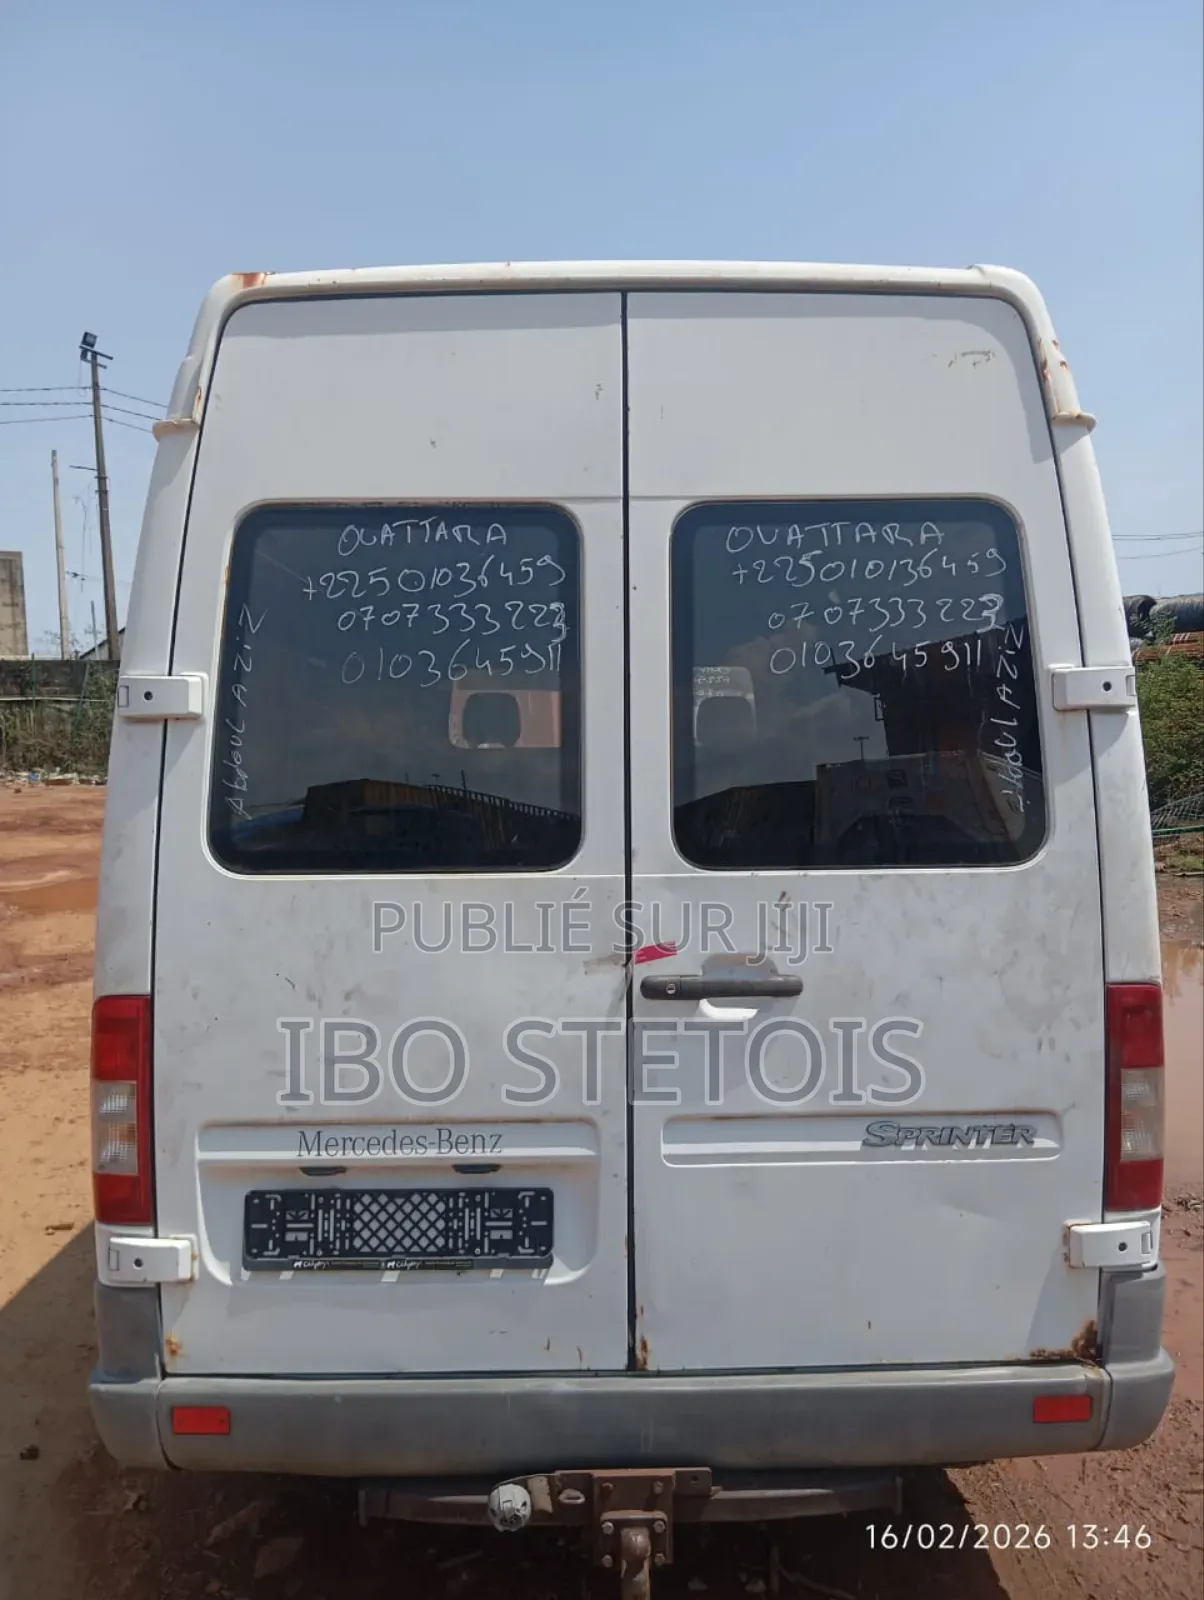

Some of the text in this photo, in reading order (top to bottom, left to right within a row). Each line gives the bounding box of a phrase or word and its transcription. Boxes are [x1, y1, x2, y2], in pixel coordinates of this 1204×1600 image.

[337, 515, 508, 556] OUATTARA
[725, 520, 945, 553] OUATTARA
[297, 1127, 504, 1158] Mercedes-Benz
